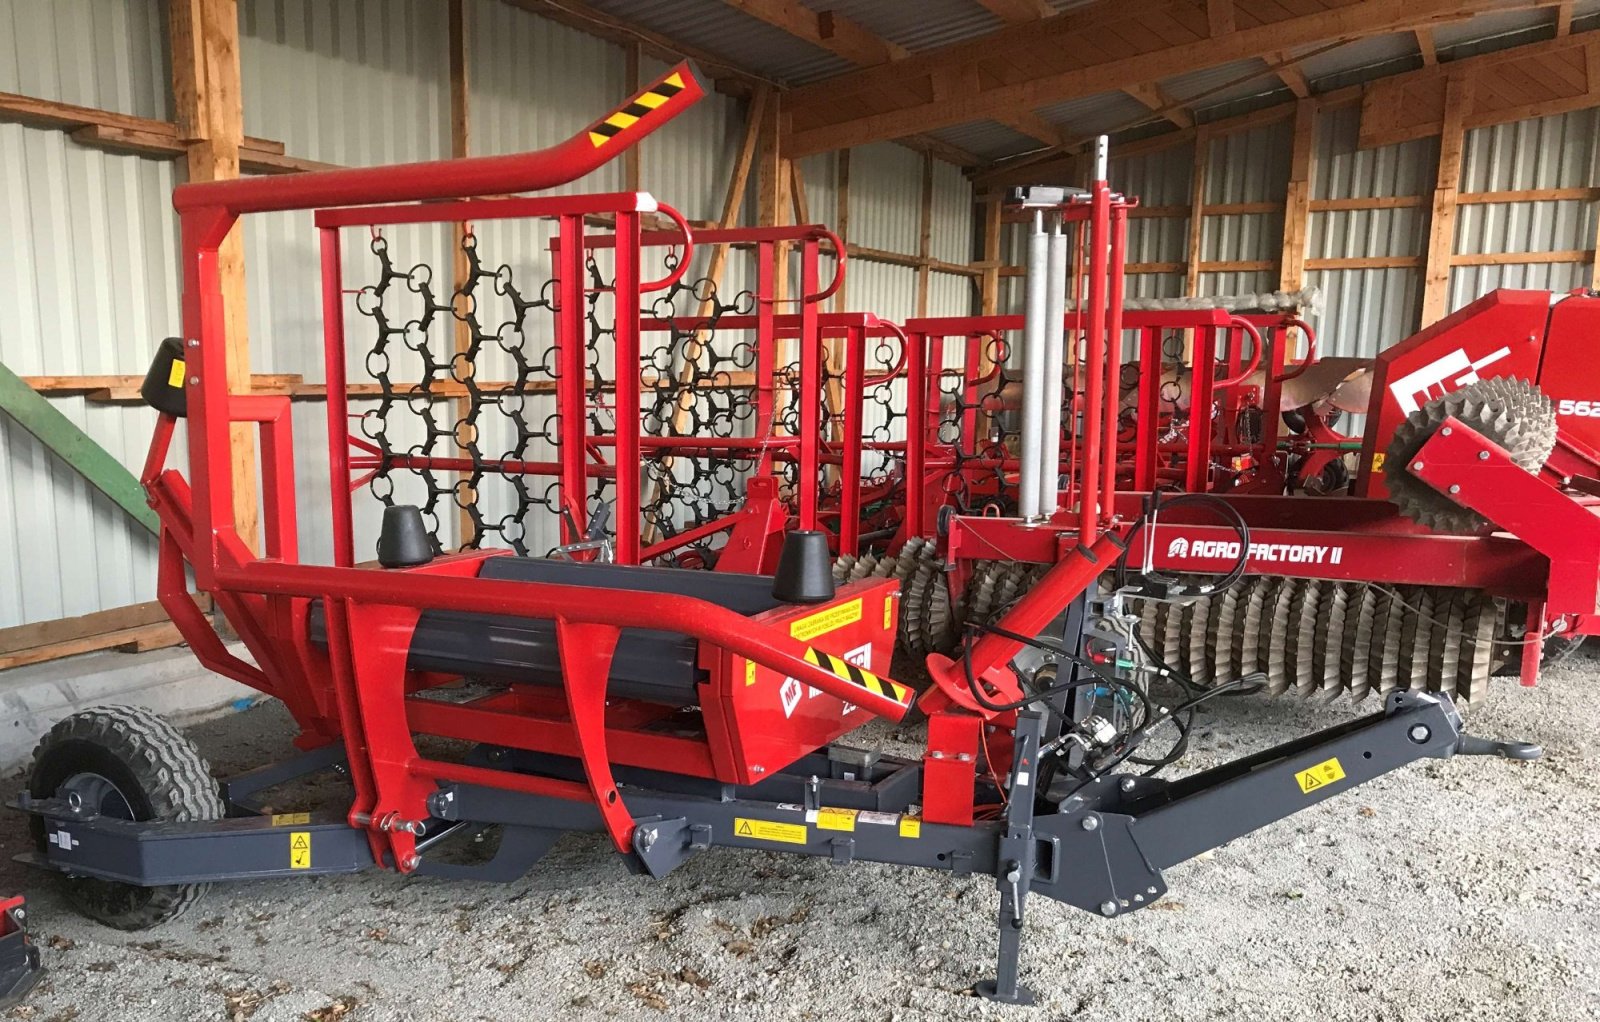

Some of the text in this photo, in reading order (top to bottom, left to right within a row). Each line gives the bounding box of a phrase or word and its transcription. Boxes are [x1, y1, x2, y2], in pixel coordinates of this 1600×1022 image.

[1191, 540, 1241, 559] AGRO
[1246, 543, 1328, 564] FACTORY
[1330, 547, 1342, 564] II
